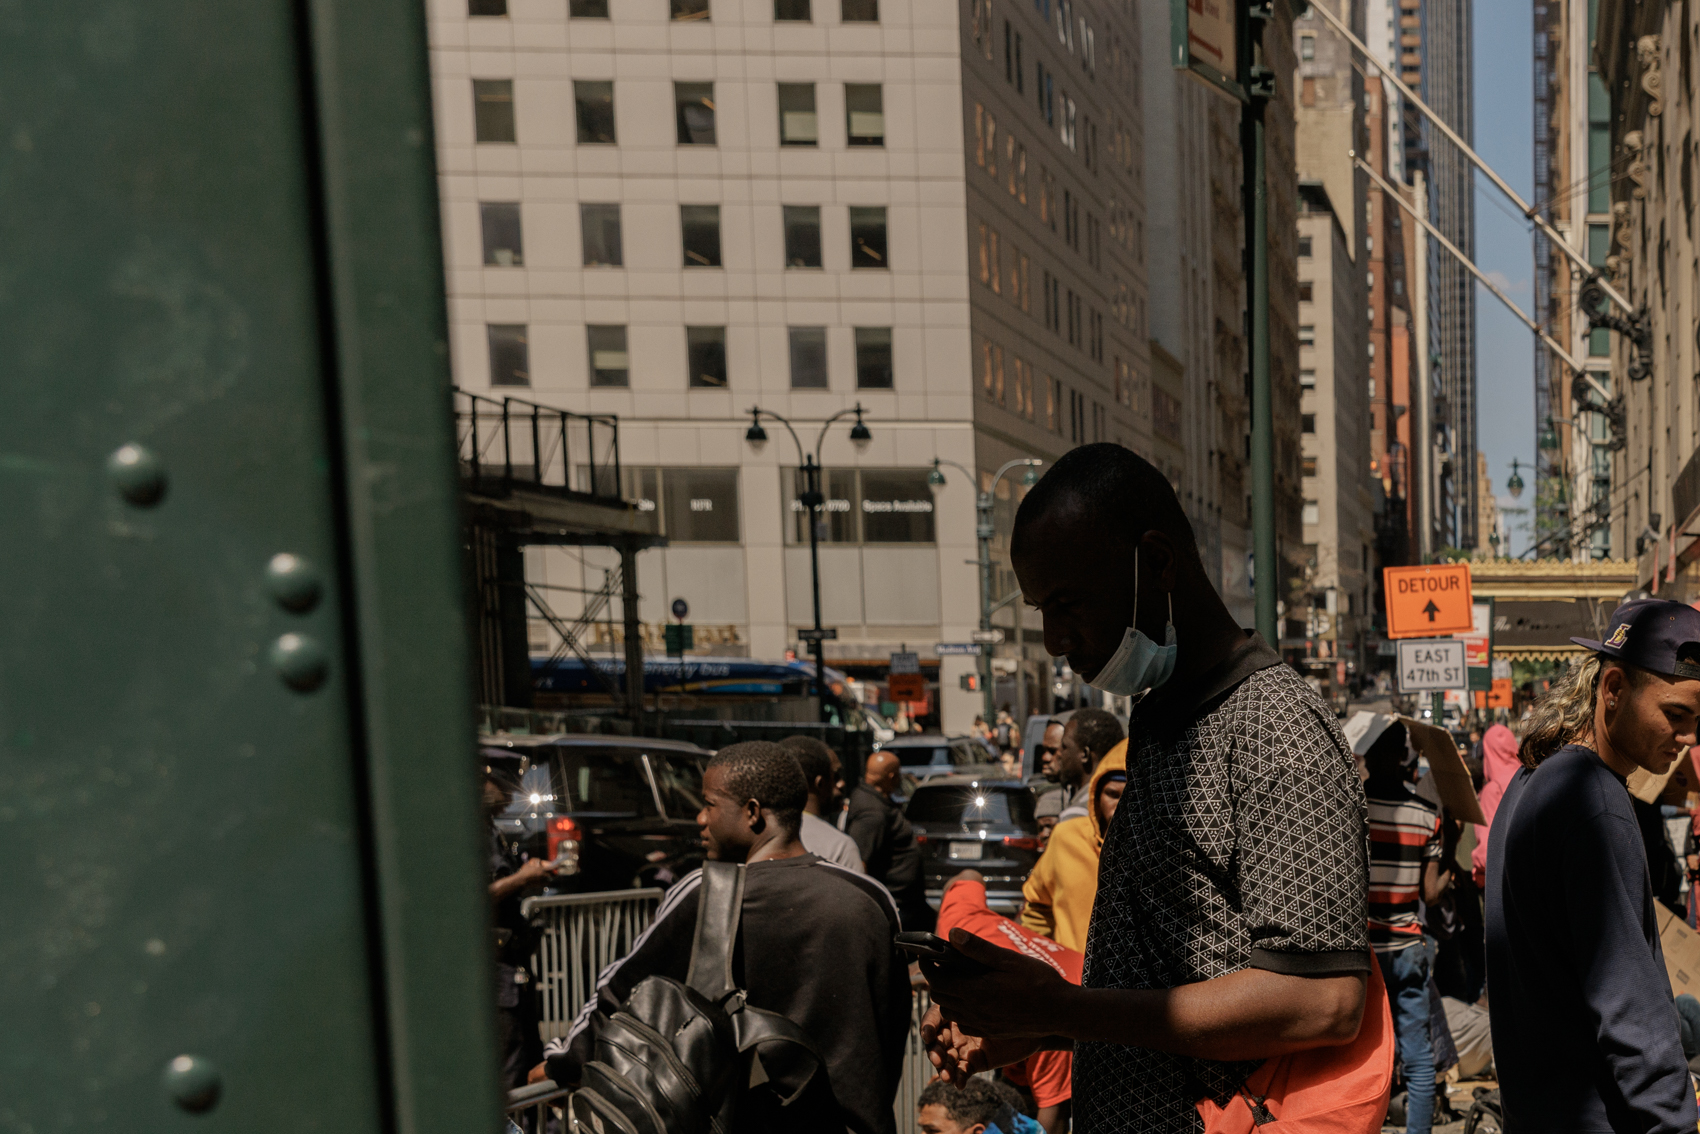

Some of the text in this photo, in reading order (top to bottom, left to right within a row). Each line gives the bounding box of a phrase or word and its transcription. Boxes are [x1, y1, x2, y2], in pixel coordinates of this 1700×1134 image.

[1398, 575, 1460, 594] DETOUR
[1415, 648, 1450, 664] EAST
[701, 662, 730, 676] bus
[1406, 667, 1460, 682] 47th ST
